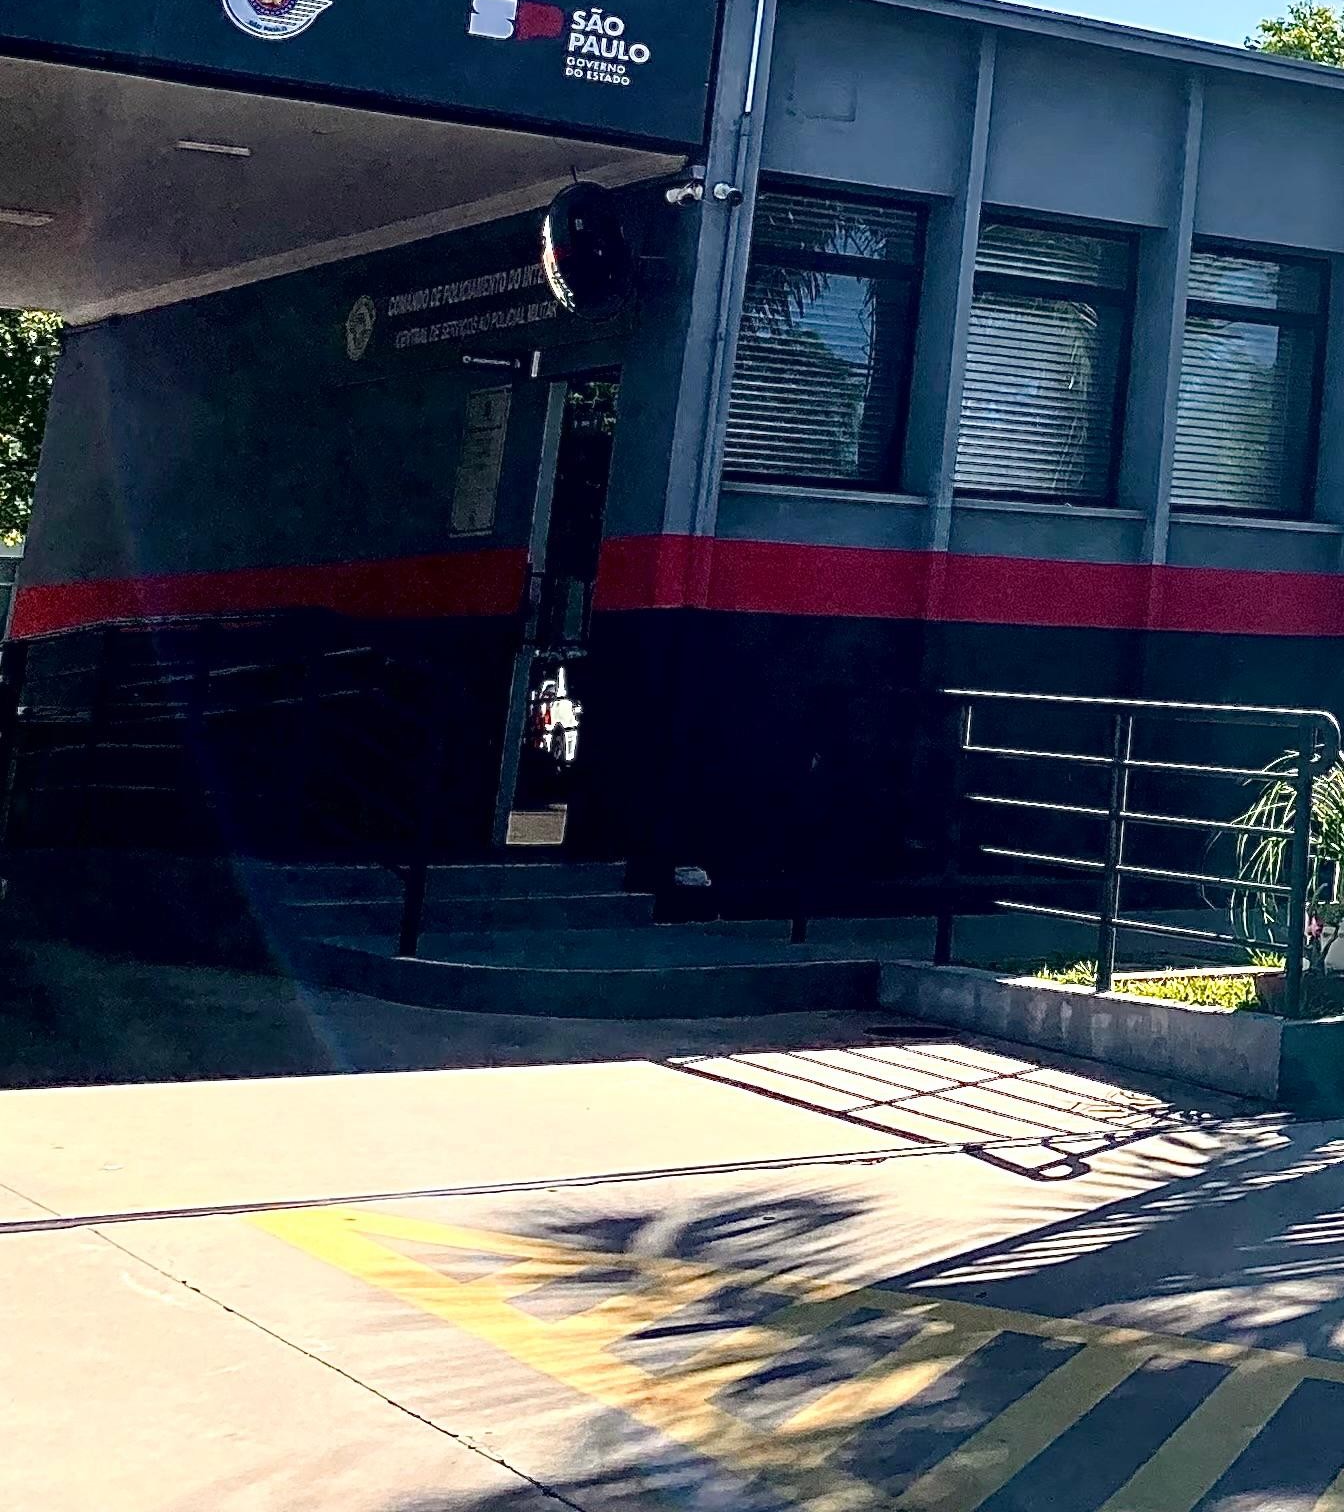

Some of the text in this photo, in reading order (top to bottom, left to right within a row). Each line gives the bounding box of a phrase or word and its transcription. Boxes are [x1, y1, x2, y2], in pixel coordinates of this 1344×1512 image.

[571, 8, 625, 36] SÃO
[568, 32, 650, 63] PAULO
[565, 67, 630, 86] DO ESTADO
[566, 57, 626, 74] GOVERNO
[388, 289, 429, 316] COMANDO
[430, 286, 442, 308] DE
[443, 272, 506, 304] POLICIAMENTO
[507, 268, 521, 291] DO
